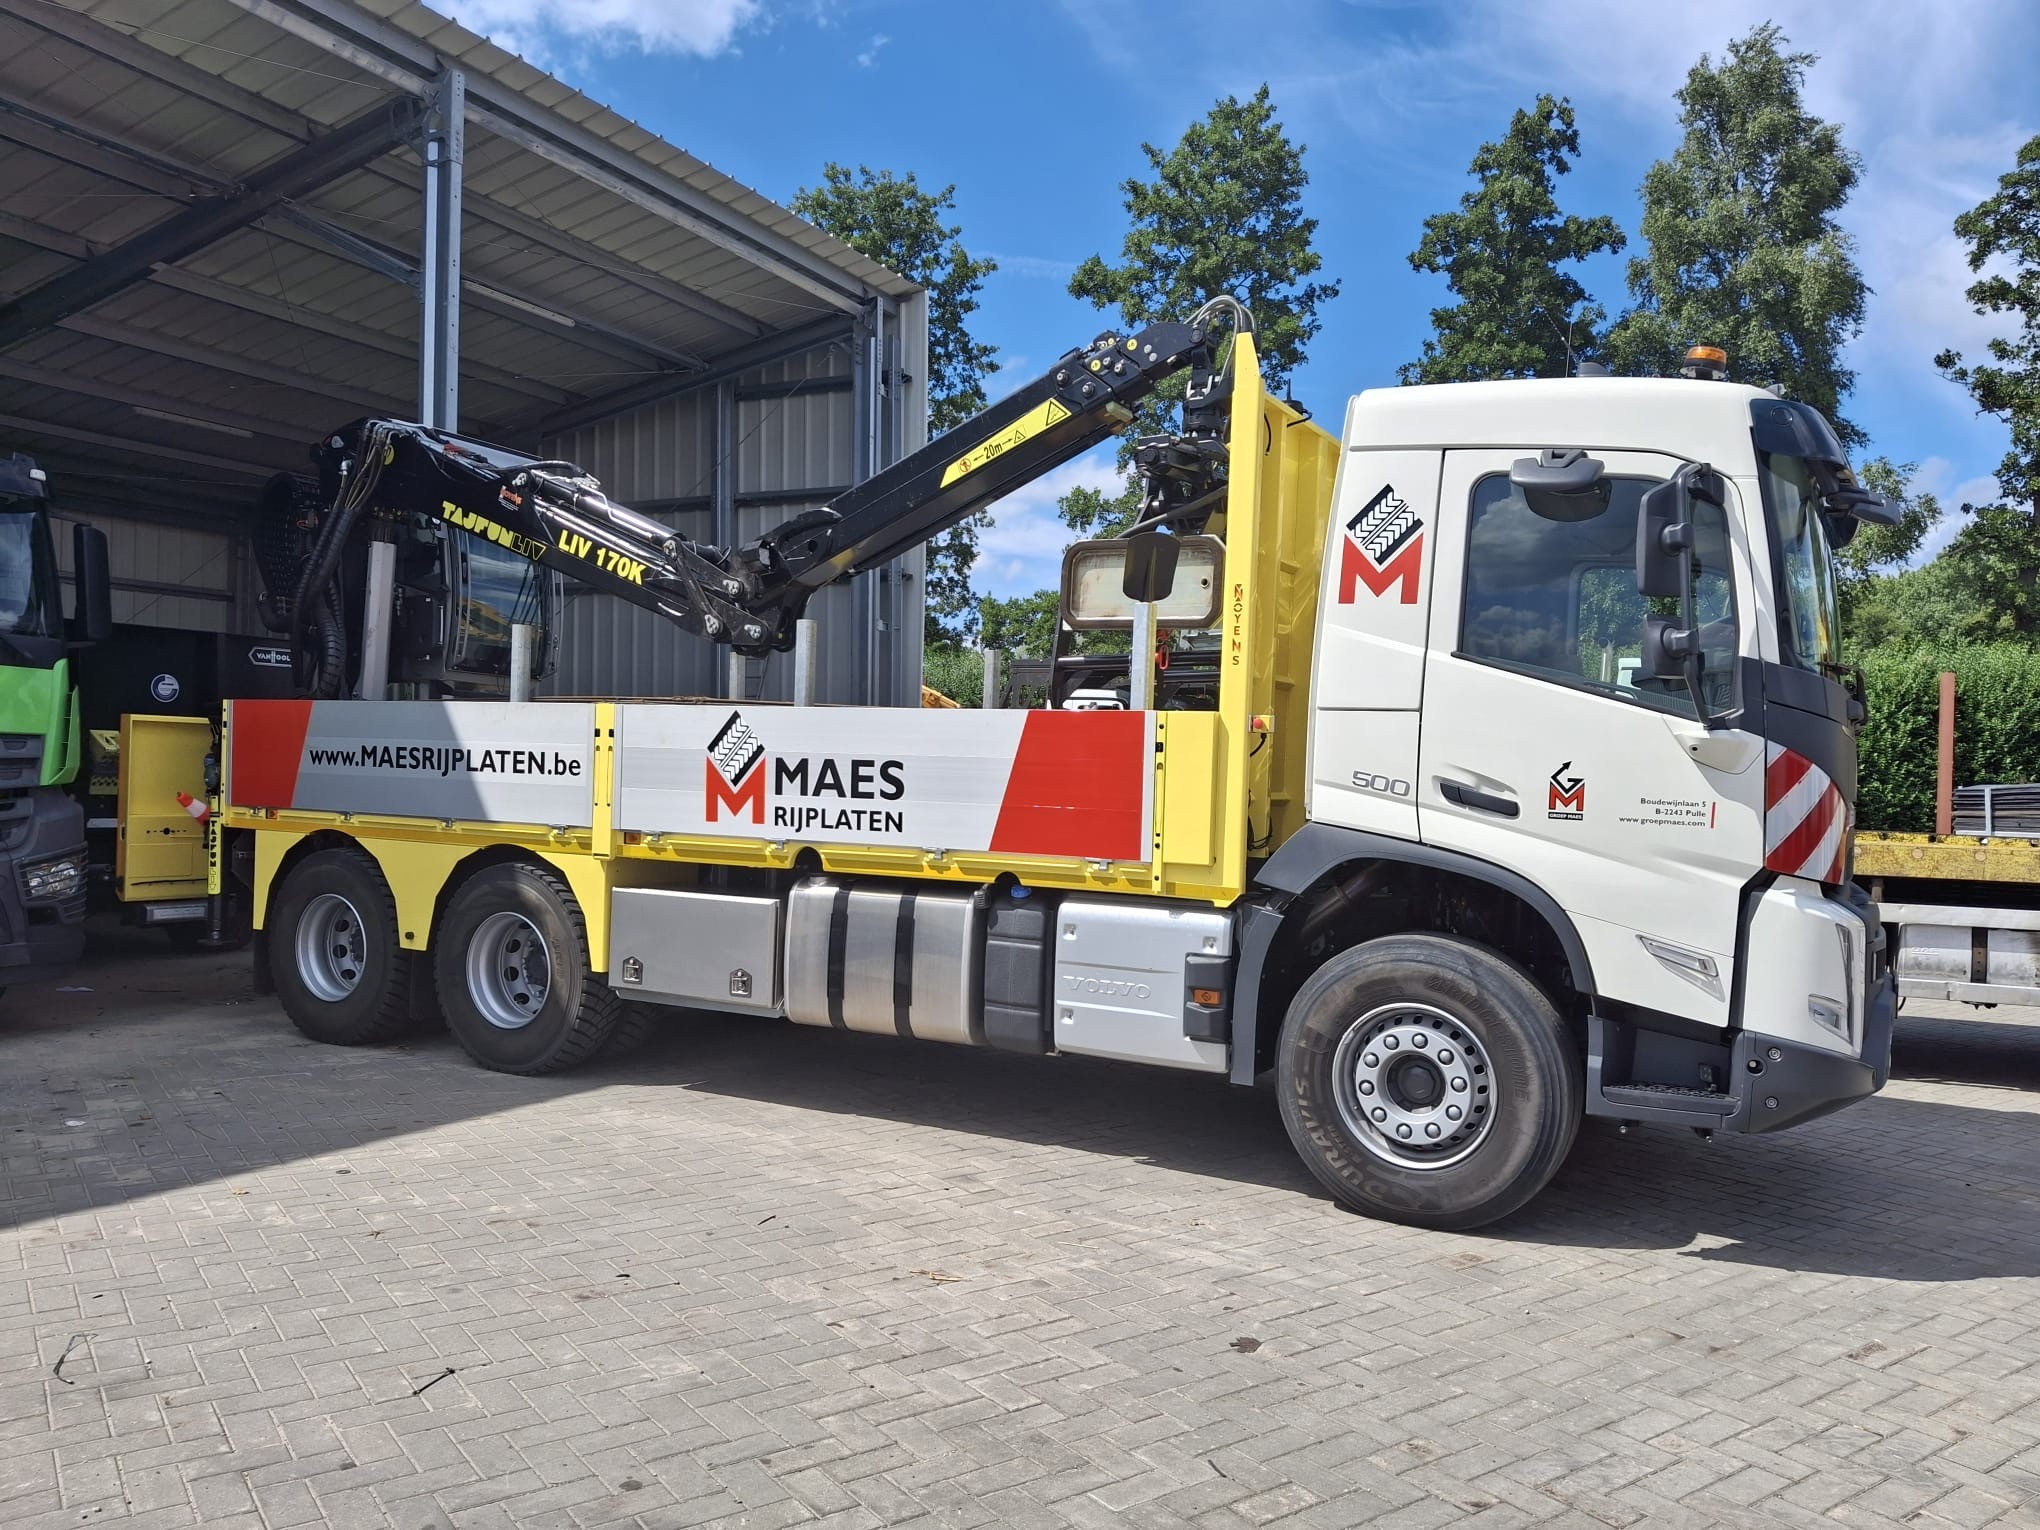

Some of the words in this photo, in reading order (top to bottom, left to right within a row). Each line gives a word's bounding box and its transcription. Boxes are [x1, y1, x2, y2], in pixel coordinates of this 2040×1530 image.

[983, 443, 1003, 460] 20m
[558, 529, 593, 559] LIV
[596, 547, 647, 585] 170K
[1232, 583, 1243, 666] NOYENS
[309, 745, 582, 777] www.MAESRIJPLATEN.be
[774, 757, 905, 801] MAES
[1352, 770, 1410, 797] 500
[1640, 798, 1700, 808] Boudewijnlaan
[1655, 808, 1683, 816] B-2243
[1685, 809, 1706, 817] Pulle
[774, 806, 904, 833] RIJPLATEN
[1062, 975, 1152, 999] VOLVO
